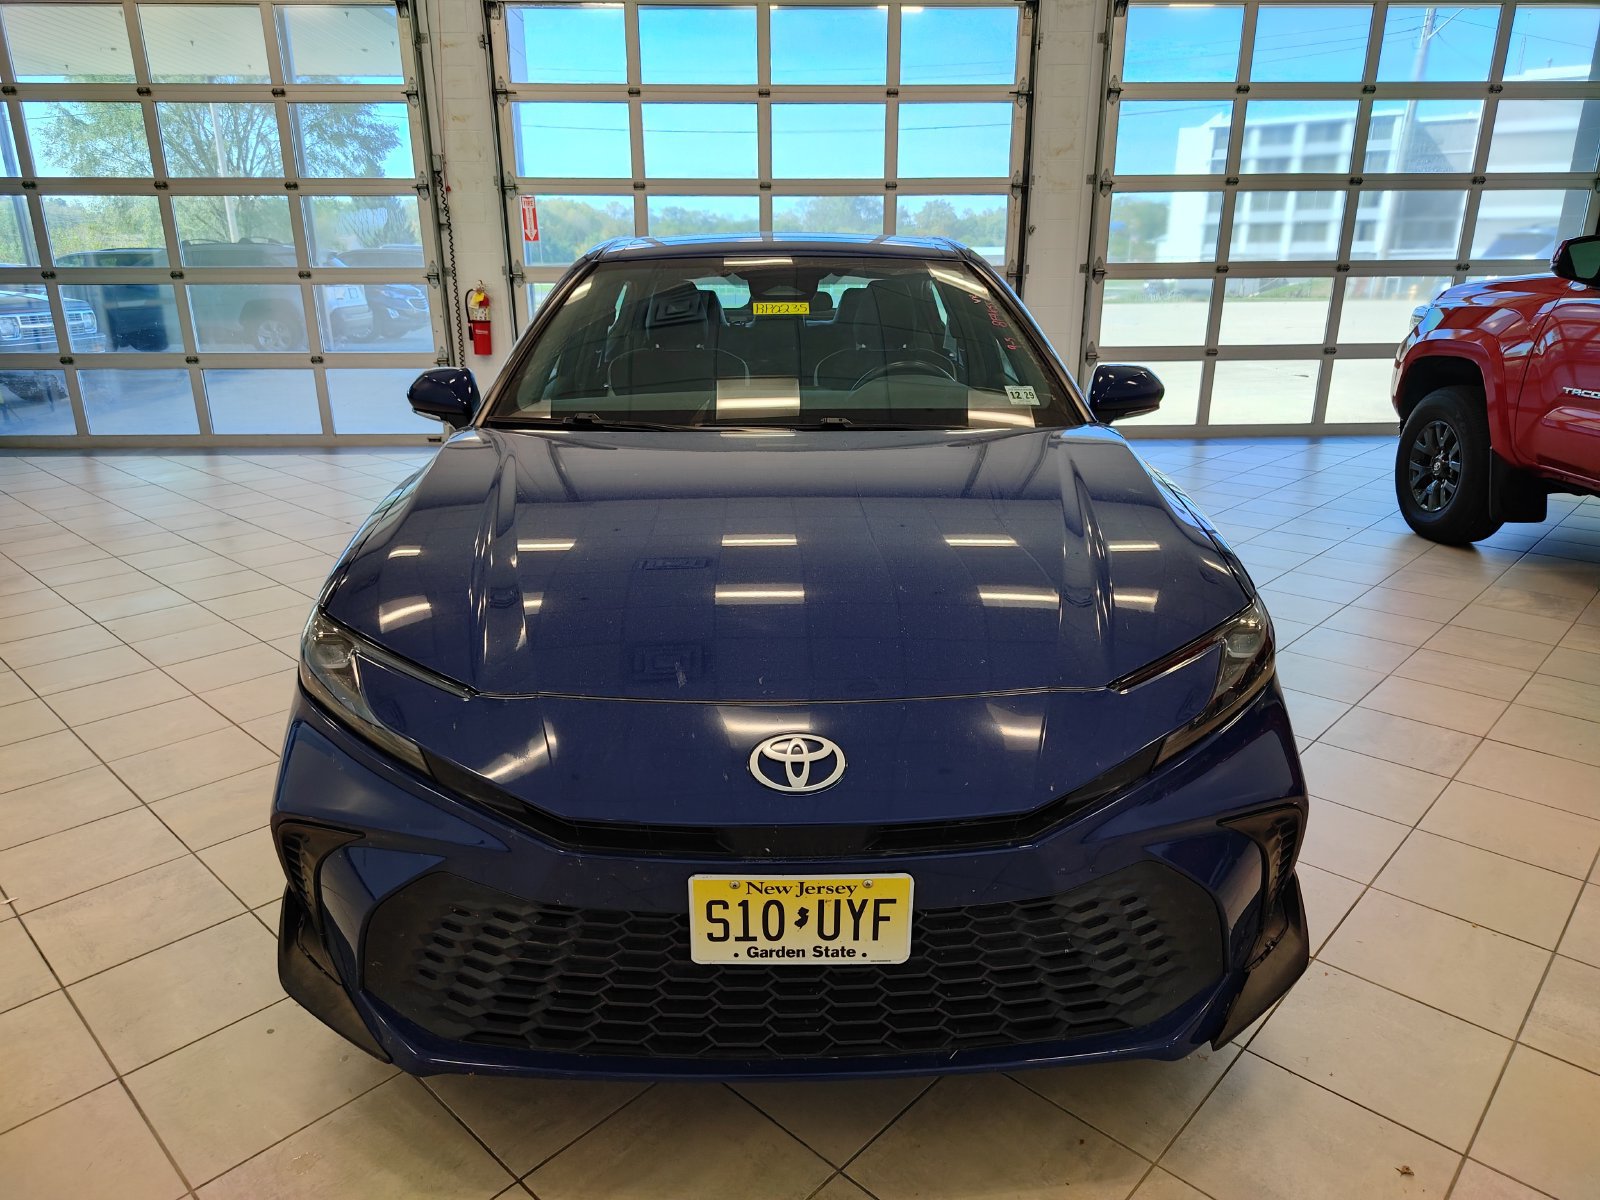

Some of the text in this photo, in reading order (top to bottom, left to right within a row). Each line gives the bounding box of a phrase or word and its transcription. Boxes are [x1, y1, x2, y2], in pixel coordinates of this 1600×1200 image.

[1010, 391, 1022, 400] 12
[746, 880, 858, 897] New Jersey
[706, 898, 897, 942] S10 UYF
[746, 945, 857, 958] Garden State
